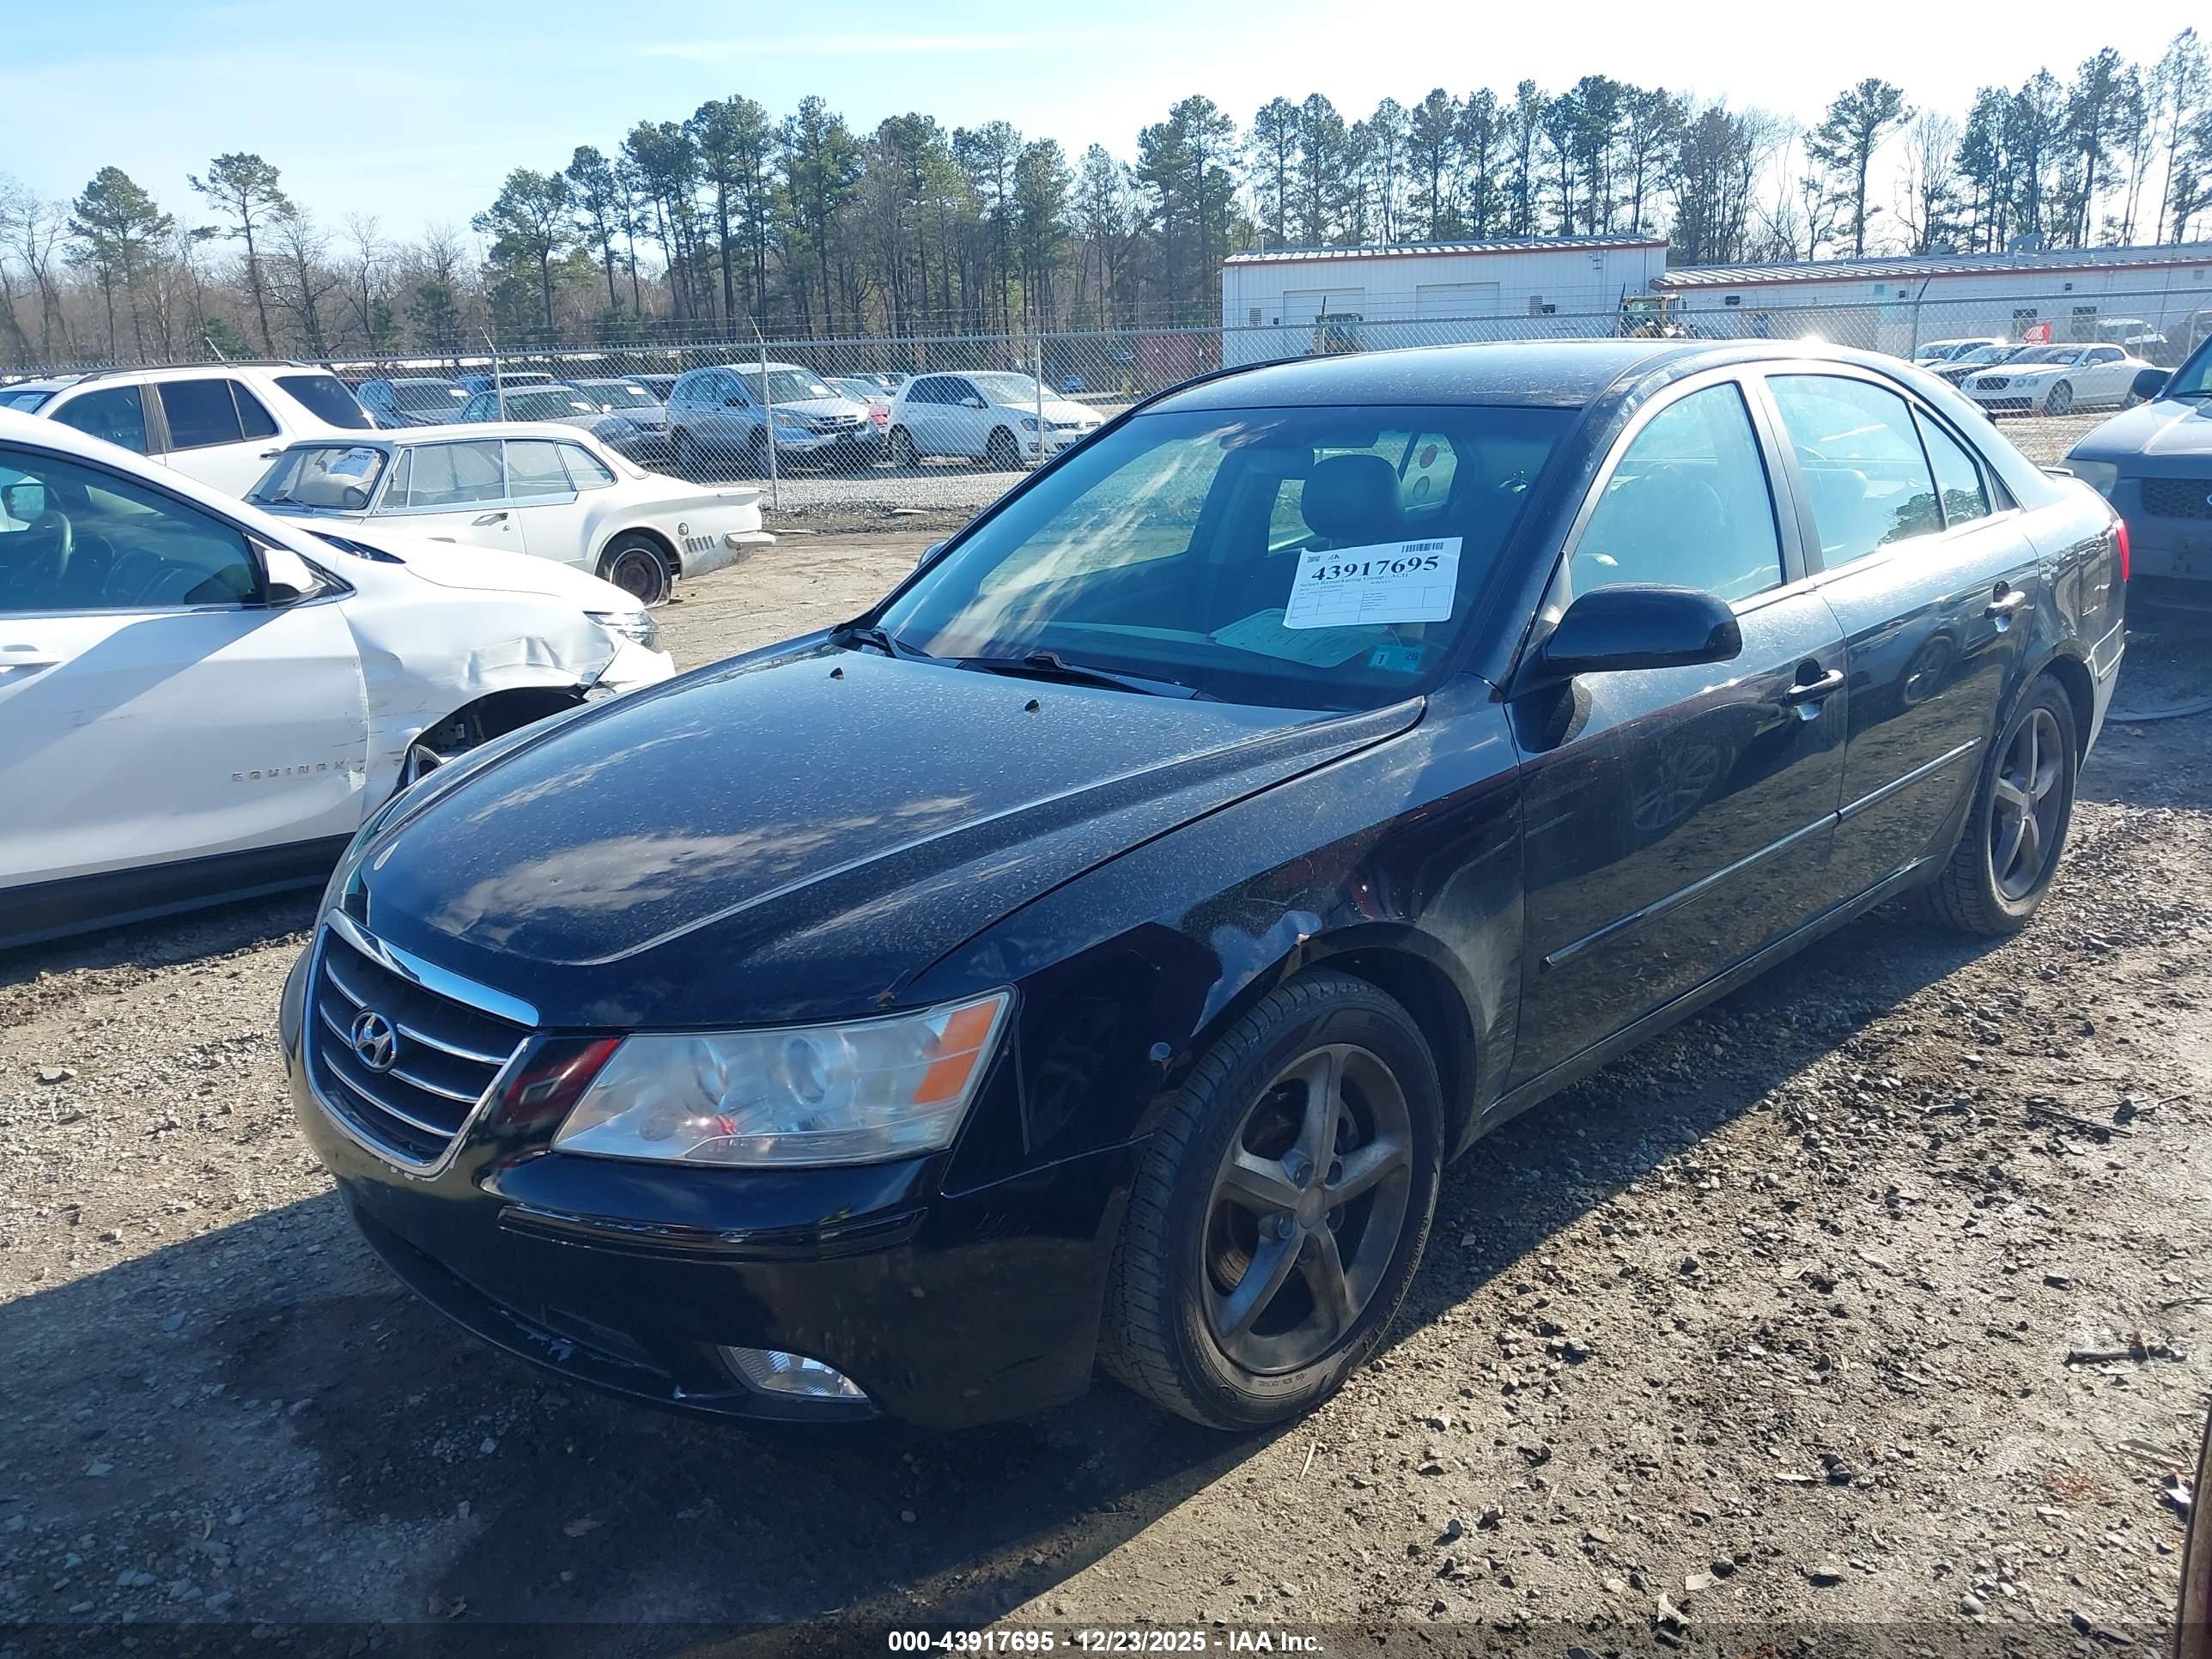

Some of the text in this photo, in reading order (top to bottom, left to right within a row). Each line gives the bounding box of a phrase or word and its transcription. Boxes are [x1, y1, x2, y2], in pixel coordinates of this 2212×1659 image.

[1311, 556, 1440, 581] 43917695
[1321, 577, 1362, 586] Remarketing
[1378, 653, 1386, 665] 1
[231, 761, 345, 782] EQUINOX
